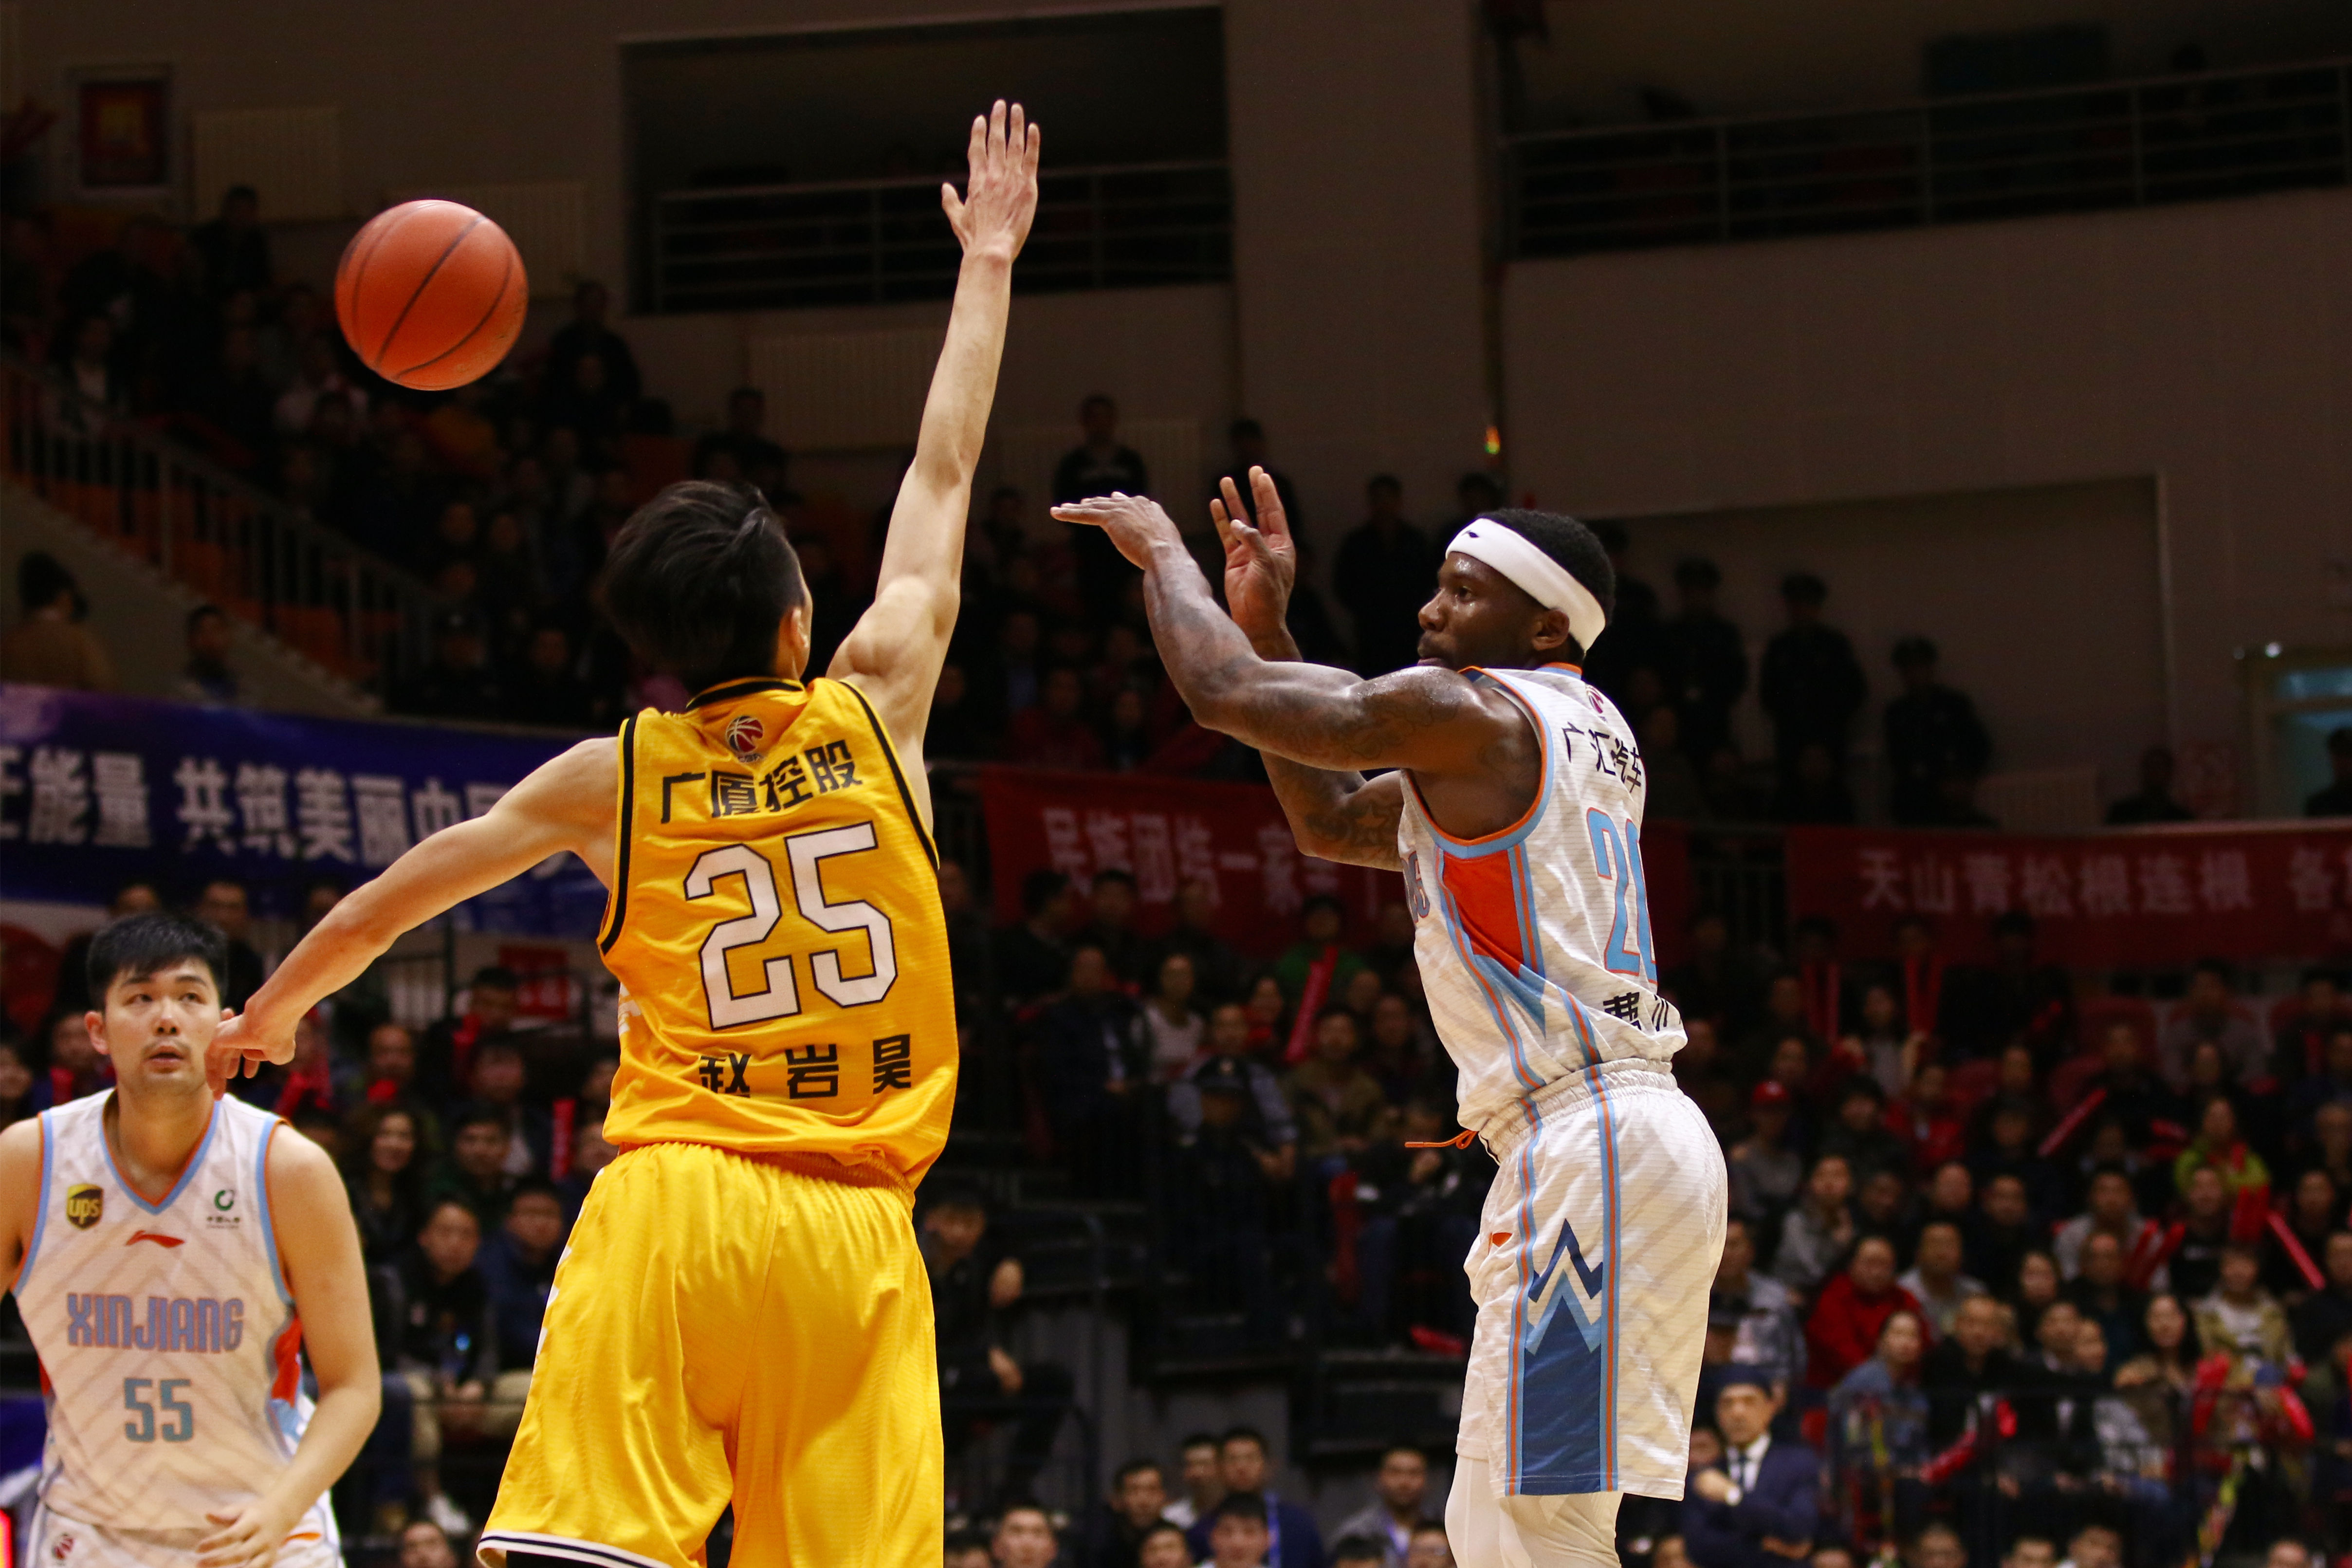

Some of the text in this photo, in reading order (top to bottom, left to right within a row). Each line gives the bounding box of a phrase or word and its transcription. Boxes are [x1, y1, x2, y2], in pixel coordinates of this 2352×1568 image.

[661, 739, 862, 824] 广厦控股
[1562, 721, 1642, 793] 广汇汽车
[171, 756, 570, 880] 共筑美丽中
[2288, 846, 2352, 911] 各
[683, 821, 899, 1031] 25
[698, 1033, 912, 1099] 赵岩昊
[69, 1199, 100, 1225] ups
[67, 1293, 243, 1354] XINJIANG
[124, 1378, 194, 1442] 55
